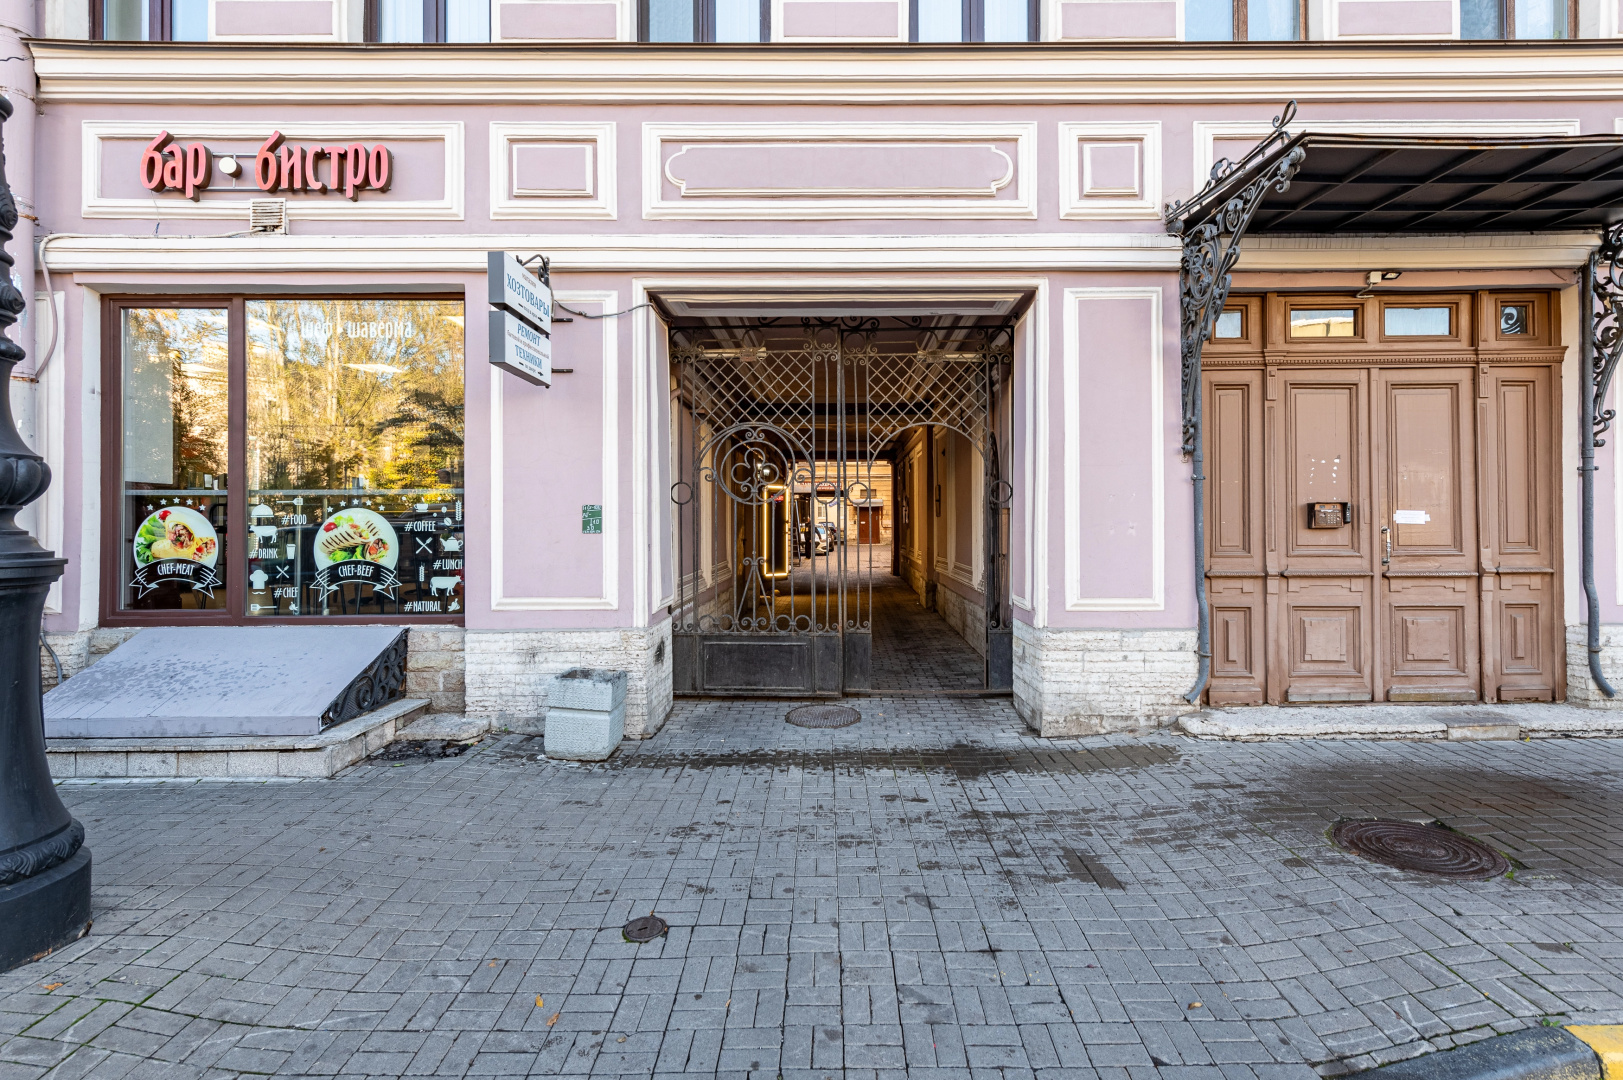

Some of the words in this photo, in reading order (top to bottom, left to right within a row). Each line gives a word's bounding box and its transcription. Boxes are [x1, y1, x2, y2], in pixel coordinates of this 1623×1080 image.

[140, 130, 211, 201] бар
[255, 130, 392, 202] бистро
[507, 273, 549, 317] ХОЗТОВАРЫ
[301, 321, 333, 340] шеф
[347, 321, 413, 341] шаверма
[517, 323, 541, 346] РЕМОНТ
[514, 344, 543, 369] ТЕХНИКИ
[281, 513, 307, 525] #FOOD
[404, 520, 437, 532] #COFFEE
[249, 548, 278, 559] #DRINK
[157, 562, 196, 576] CHEF-MEAT
[432, 559, 463, 570] #LUNCH
[338, 565, 375, 578] CHEF-BEEF
[273, 587, 299, 599] #CHEF
[404, 601, 442, 612] #NATURAL
